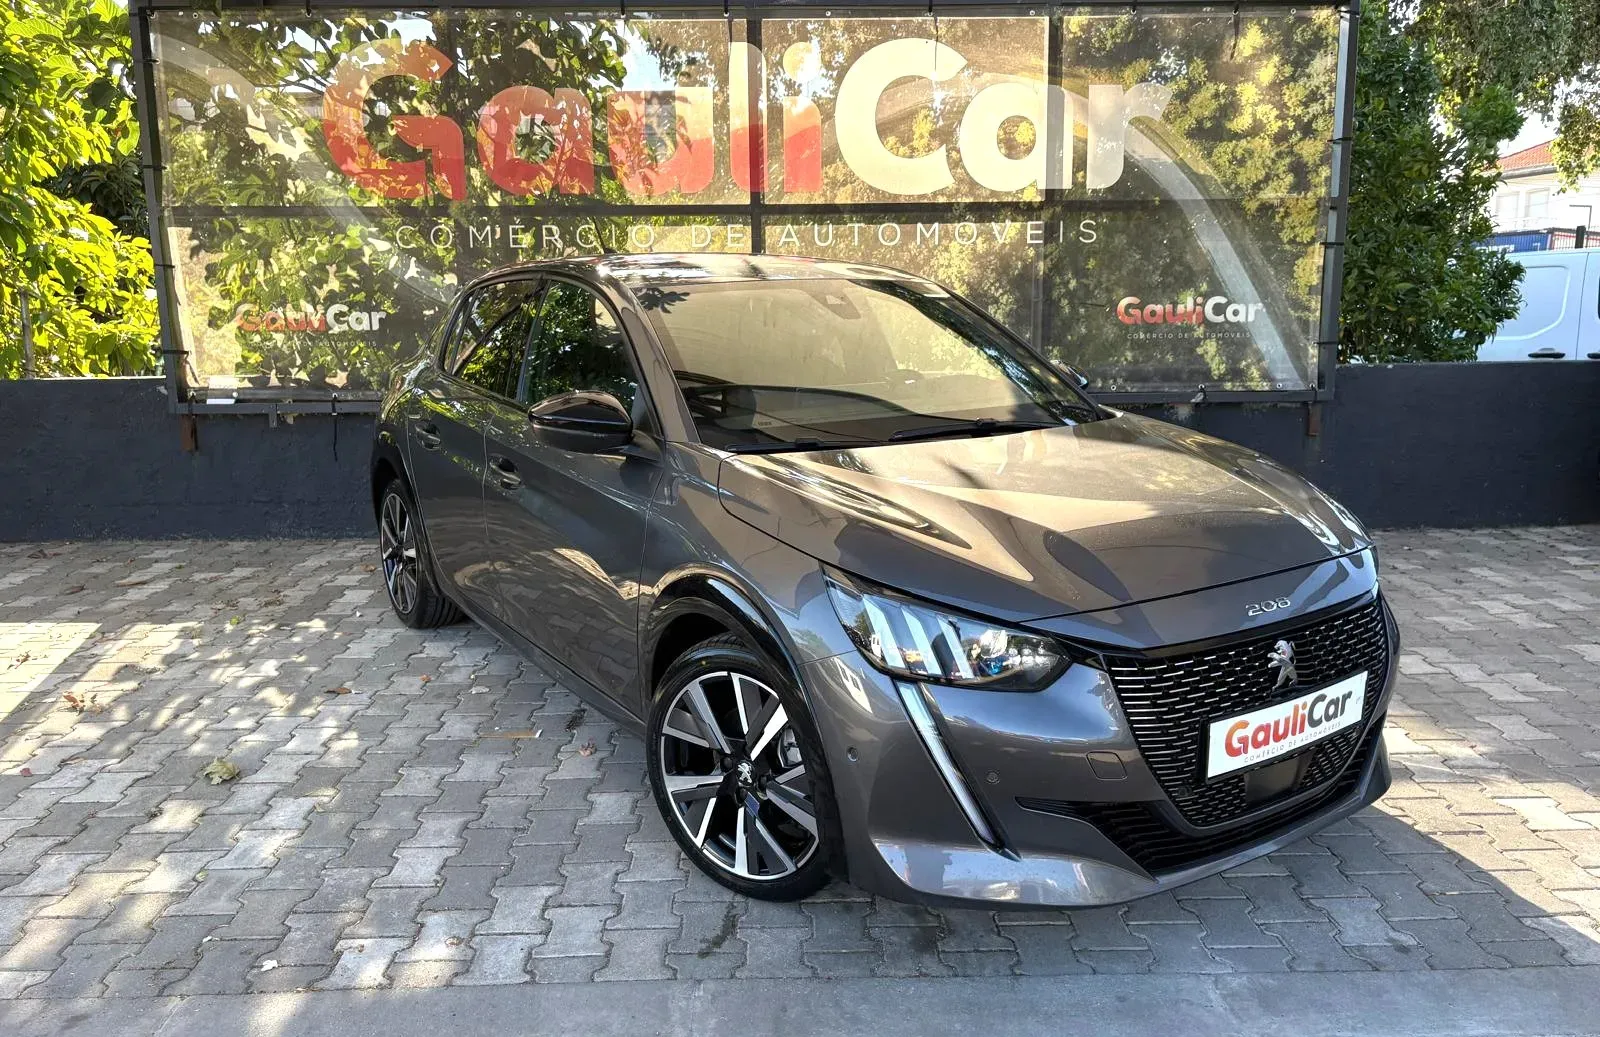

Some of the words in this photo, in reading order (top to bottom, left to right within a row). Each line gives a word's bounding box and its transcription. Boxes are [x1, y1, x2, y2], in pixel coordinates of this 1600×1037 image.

[323, 37, 1173, 200] GauliCar
[395, 217, 655, 248] COMÉRCIO
[691, 223, 745, 248] DE
[1116, 295, 1264, 326] GauliCar
[1245, 596, 1292, 617] 208
[1224, 690, 1353, 758] GauliCar
